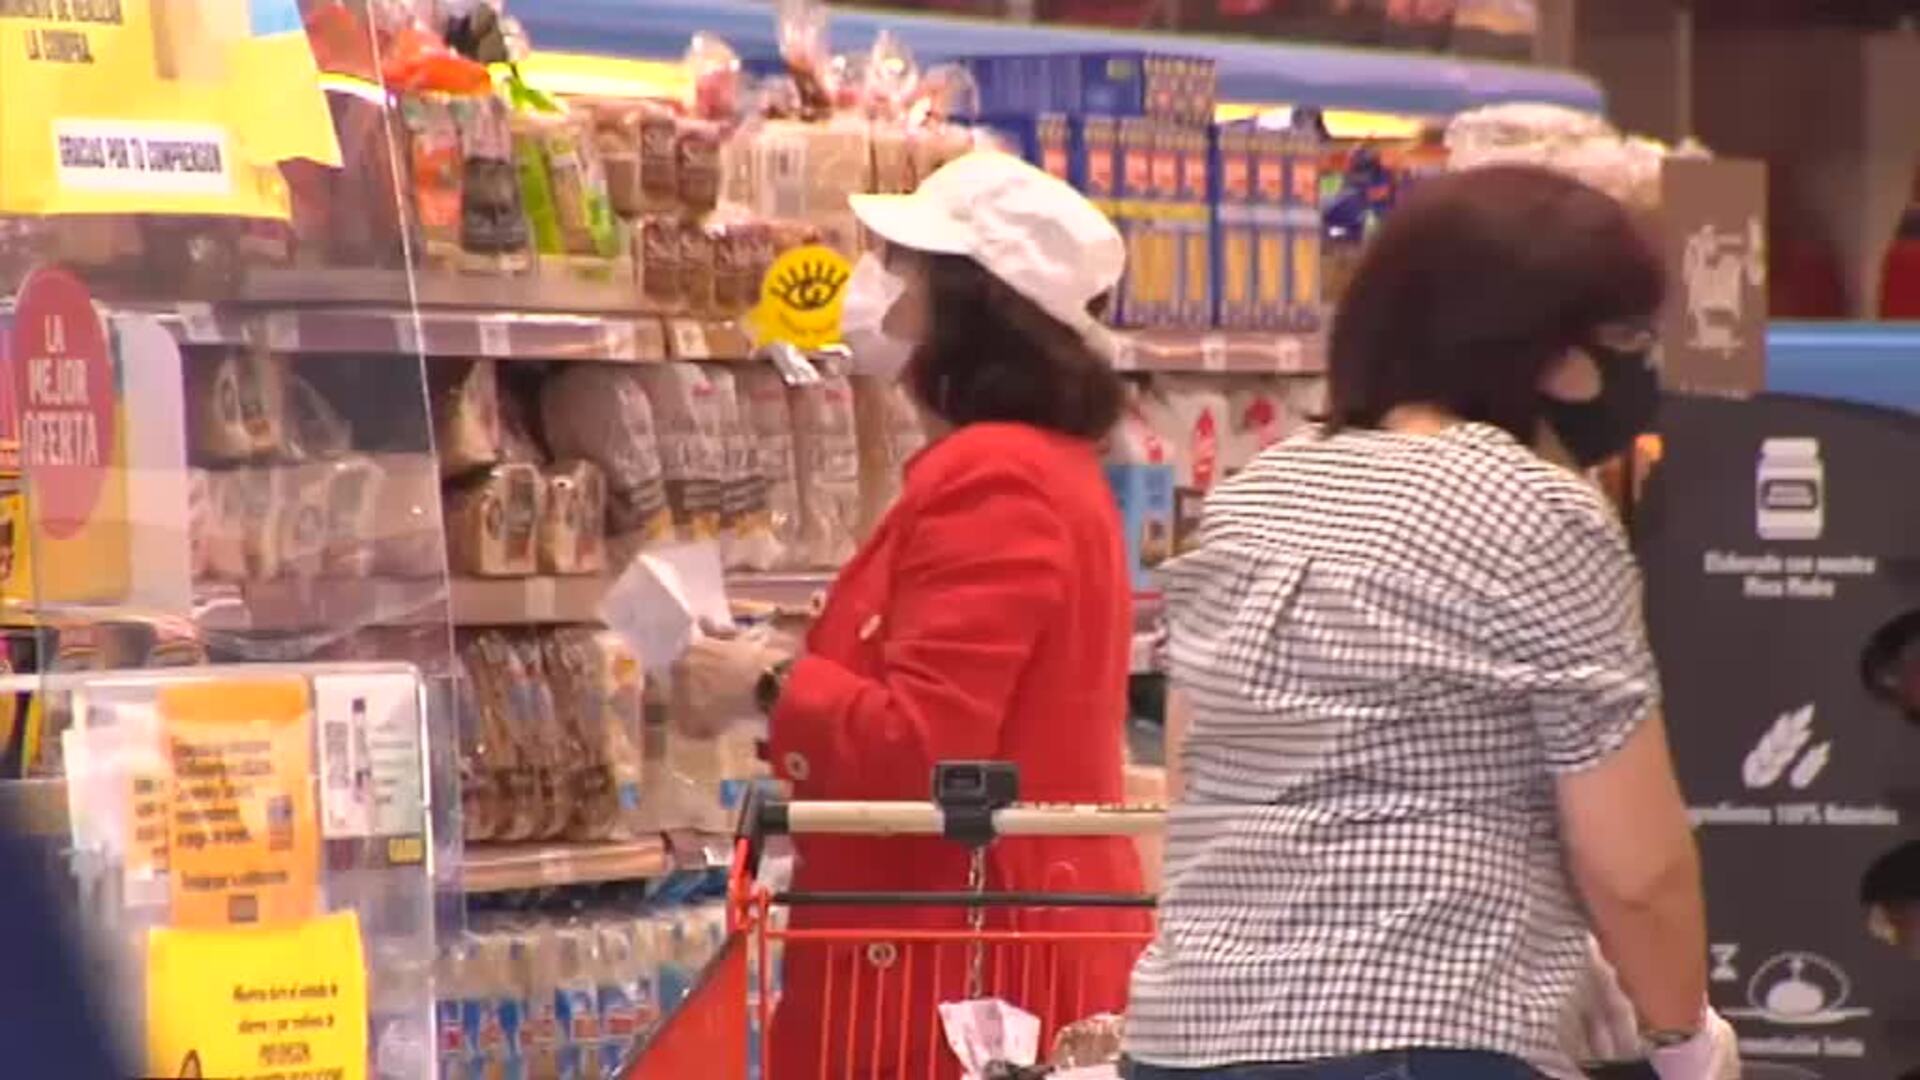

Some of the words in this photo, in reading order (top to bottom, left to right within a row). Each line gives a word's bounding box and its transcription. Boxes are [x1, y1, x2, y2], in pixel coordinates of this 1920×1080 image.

[59, 135, 105, 168] GRACIAS
[106, 137, 129, 169] POR
[45, 314, 66, 353] LA
[28, 358, 89, 405] MEJOR
[23, 409, 99, 467] OFERTA
